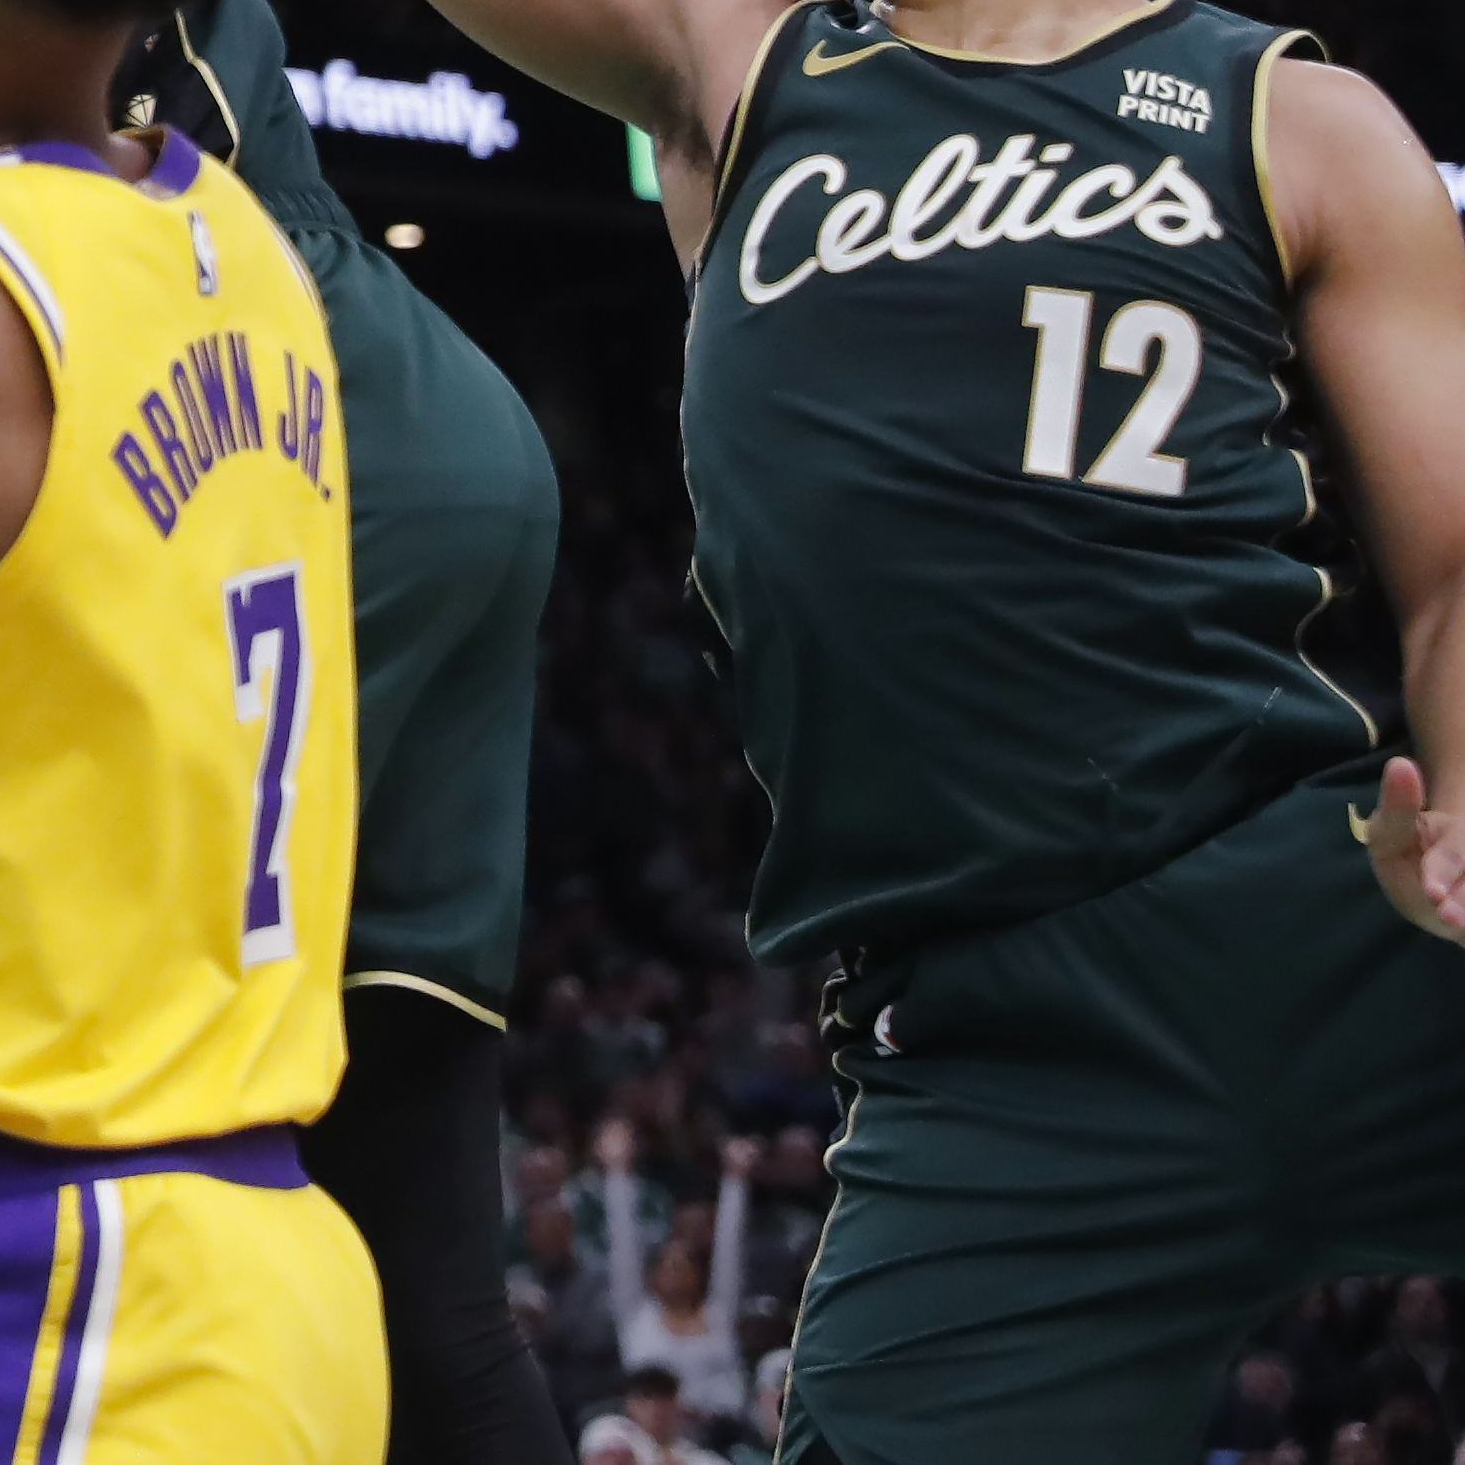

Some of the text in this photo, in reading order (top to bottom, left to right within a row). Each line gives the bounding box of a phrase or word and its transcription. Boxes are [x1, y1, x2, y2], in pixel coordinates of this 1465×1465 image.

[1116, 94, 1212, 134] PRINT
[1122, 68, 1212, 117] VISTA
[739, 134, 1223, 305] Celtics
[110, 331, 331, 541] BROWN JR.
[1021, 285, 1203, 498] 12
[222, 558, 305, 968] 7
